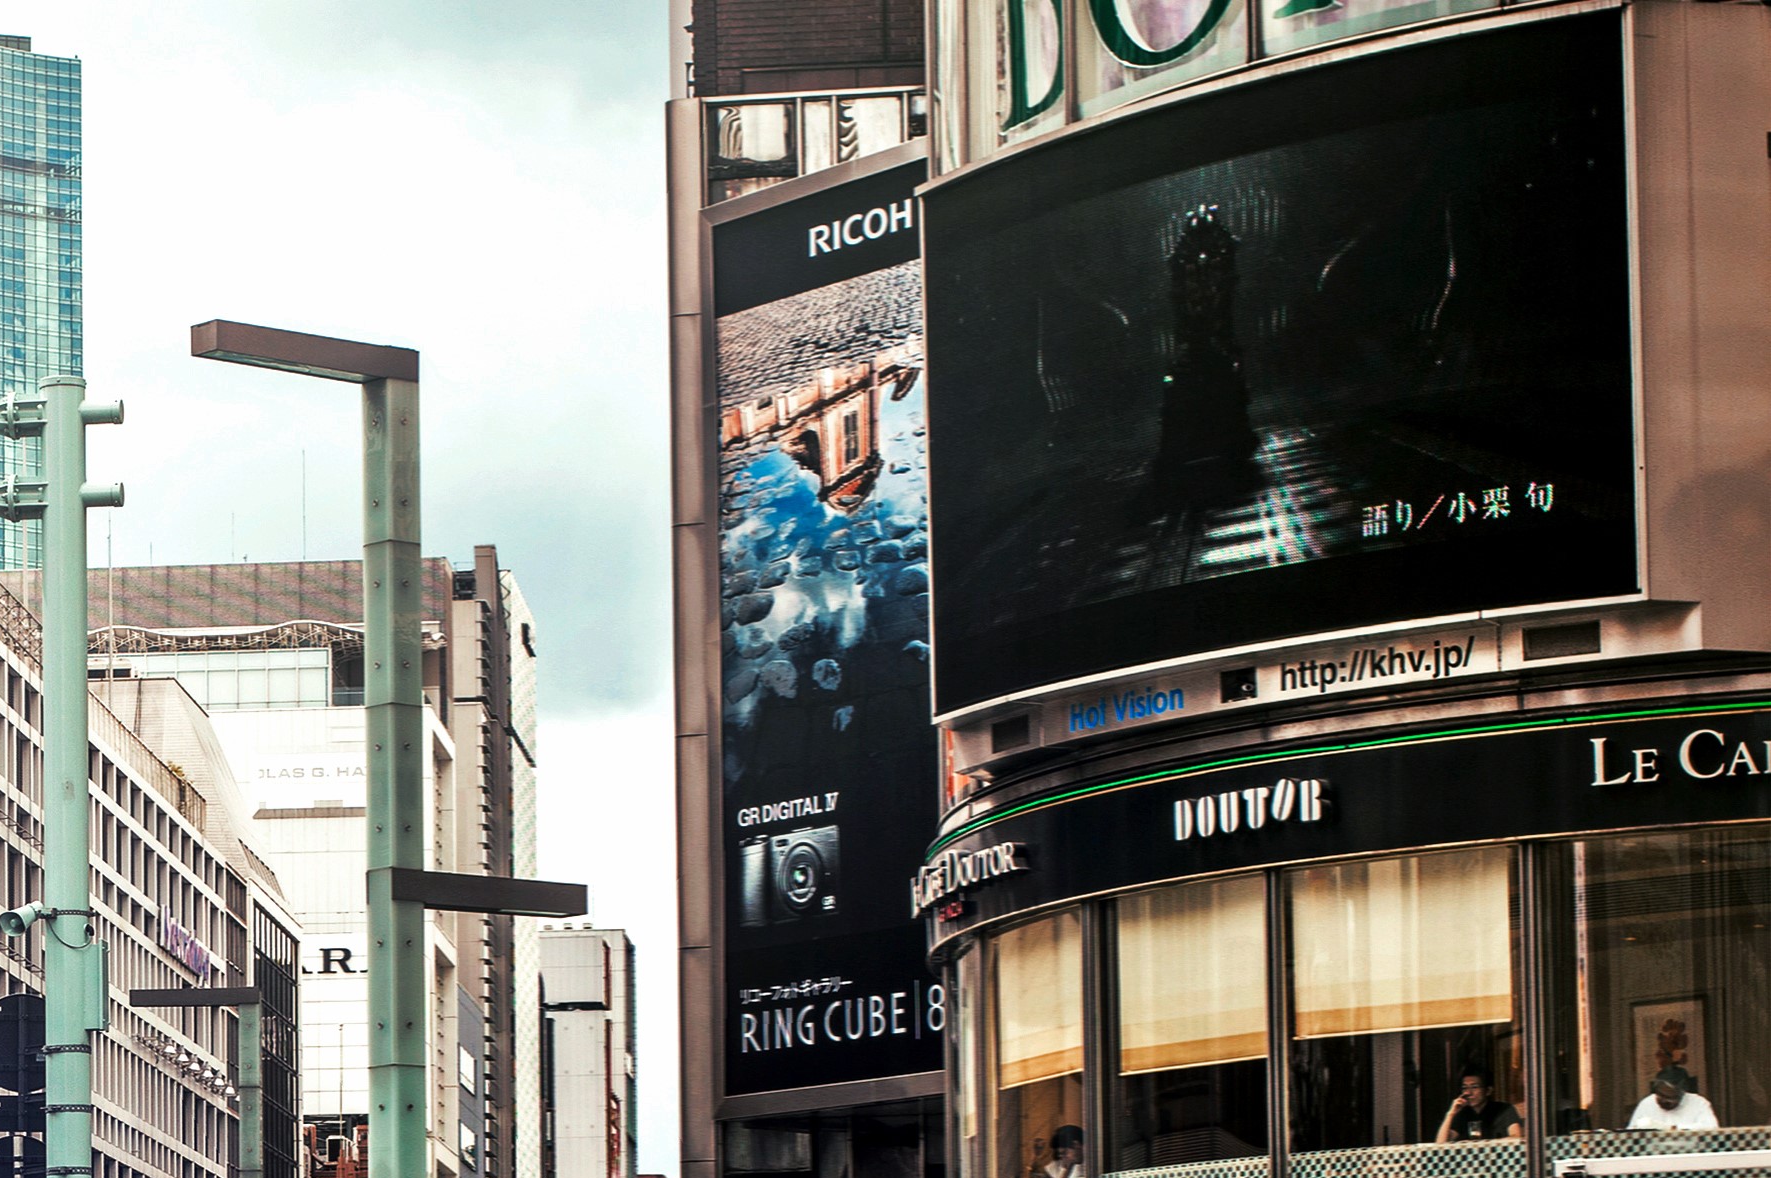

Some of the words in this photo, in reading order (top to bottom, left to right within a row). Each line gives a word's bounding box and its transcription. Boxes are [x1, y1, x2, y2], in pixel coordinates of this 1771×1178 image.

[808, 199, 914, 258] RICOH
[1280, 635, 1476, 692] http://khv.jp/
[1069, 694, 1106, 732] Hot
[1113, 686, 1185, 723] Vision
[1589, 737, 1660, 786] LE
[737, 807, 761, 827] GR
[762, 796, 823, 822] DIGITAL
[1174, 778, 1323, 841] DOUTOR
[741, 1004, 815, 1053] RING
[824, 992, 907, 1042] CUBE
